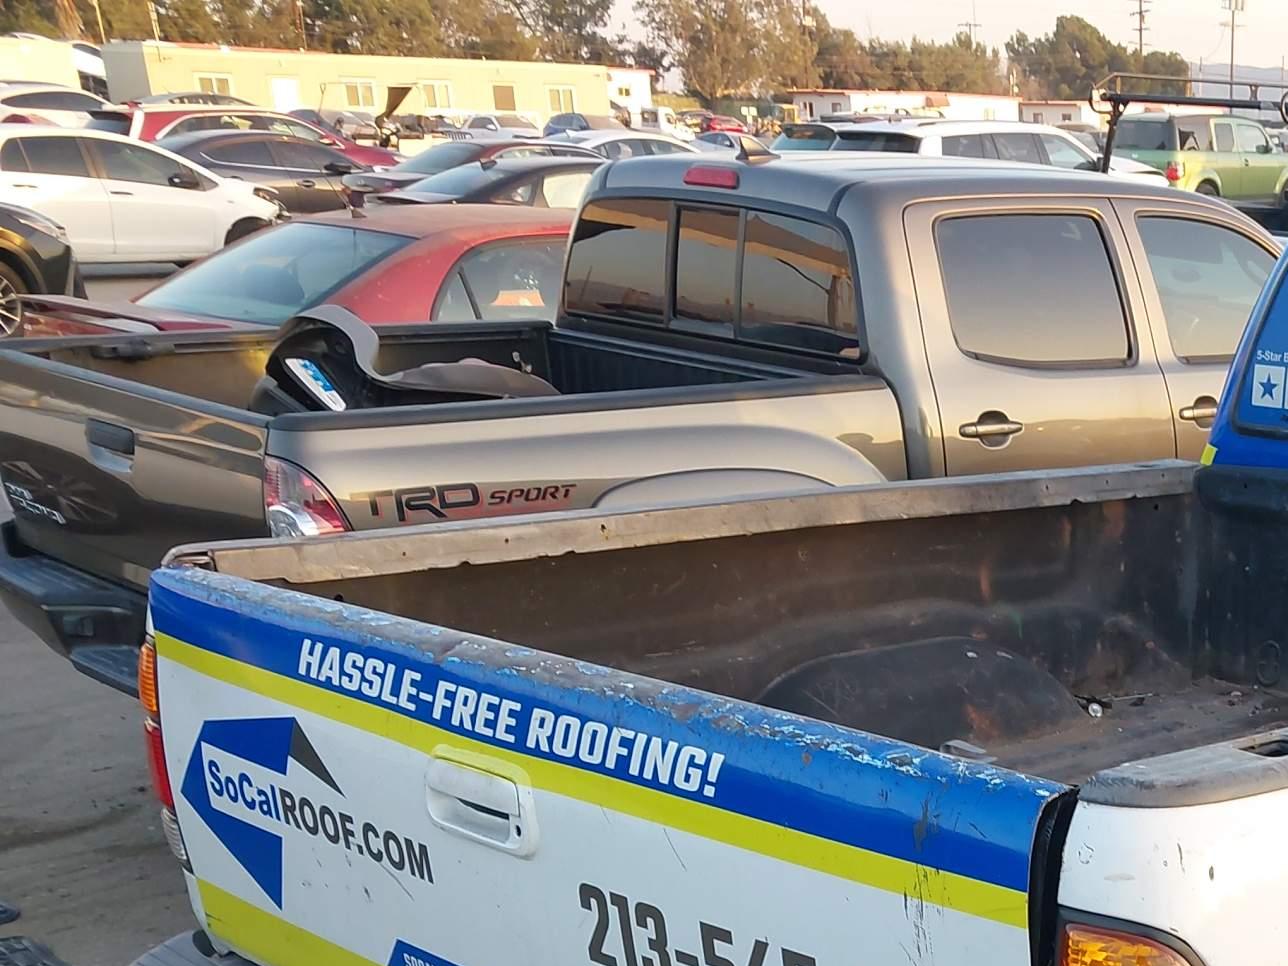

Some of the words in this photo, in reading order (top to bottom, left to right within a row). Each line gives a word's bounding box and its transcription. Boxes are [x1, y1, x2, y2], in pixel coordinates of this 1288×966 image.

[1256, 350, 1282, 362] 5-Star
[350, 482, 481, 522] TRD
[488, 484, 577, 506] SPORT
[298, 639, 521, 743] HASSLE-FREE
[526, 709, 725, 798] ROOFING!
[208, 759, 434, 884] SoCalROOF.COM
